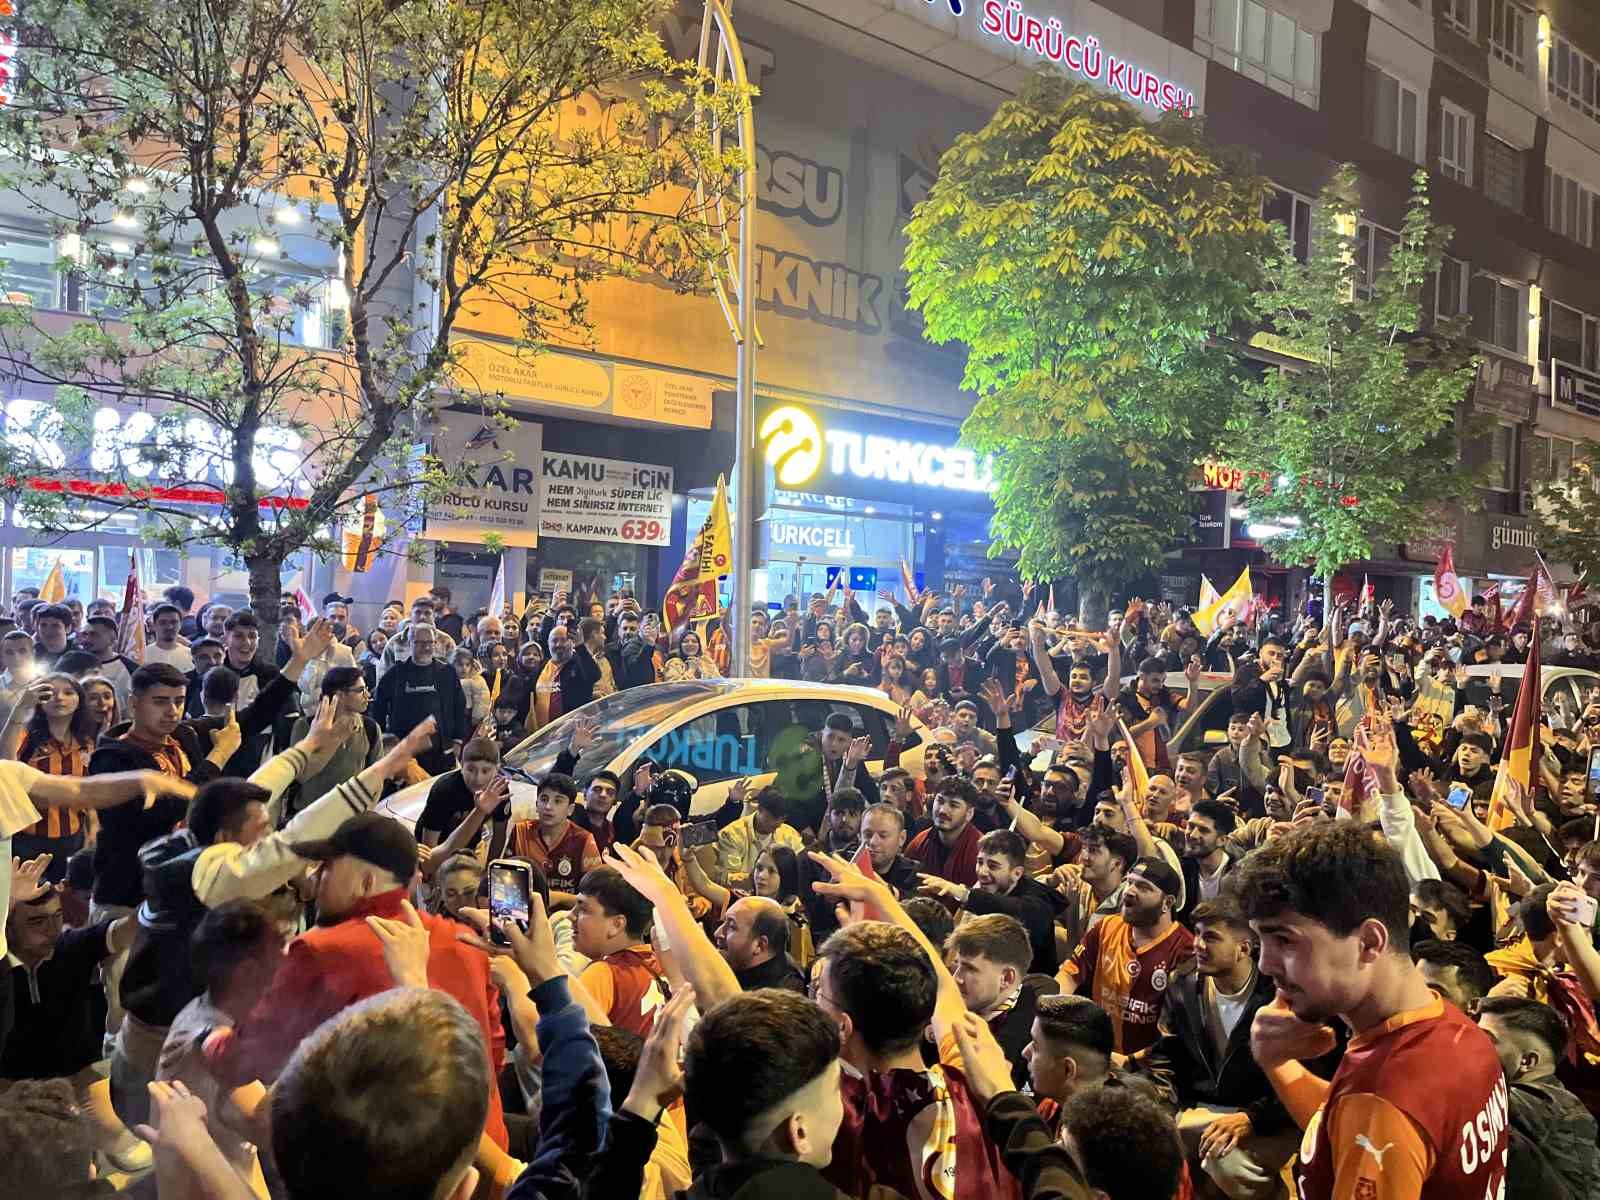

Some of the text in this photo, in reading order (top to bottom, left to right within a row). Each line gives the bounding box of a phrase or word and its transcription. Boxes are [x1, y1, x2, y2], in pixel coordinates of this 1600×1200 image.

[982, 0, 1194, 119] SÜRÜCÜ KURSU
[542, 457, 606, 482] KAMU
[549, 484, 574, 495] HEM
[484, 498, 529, 513] KURSU
[547, 497, 571, 508] HEM
[566, 522, 618, 537] KAMPANYA
[770, 521, 855, 549] URKCELL
